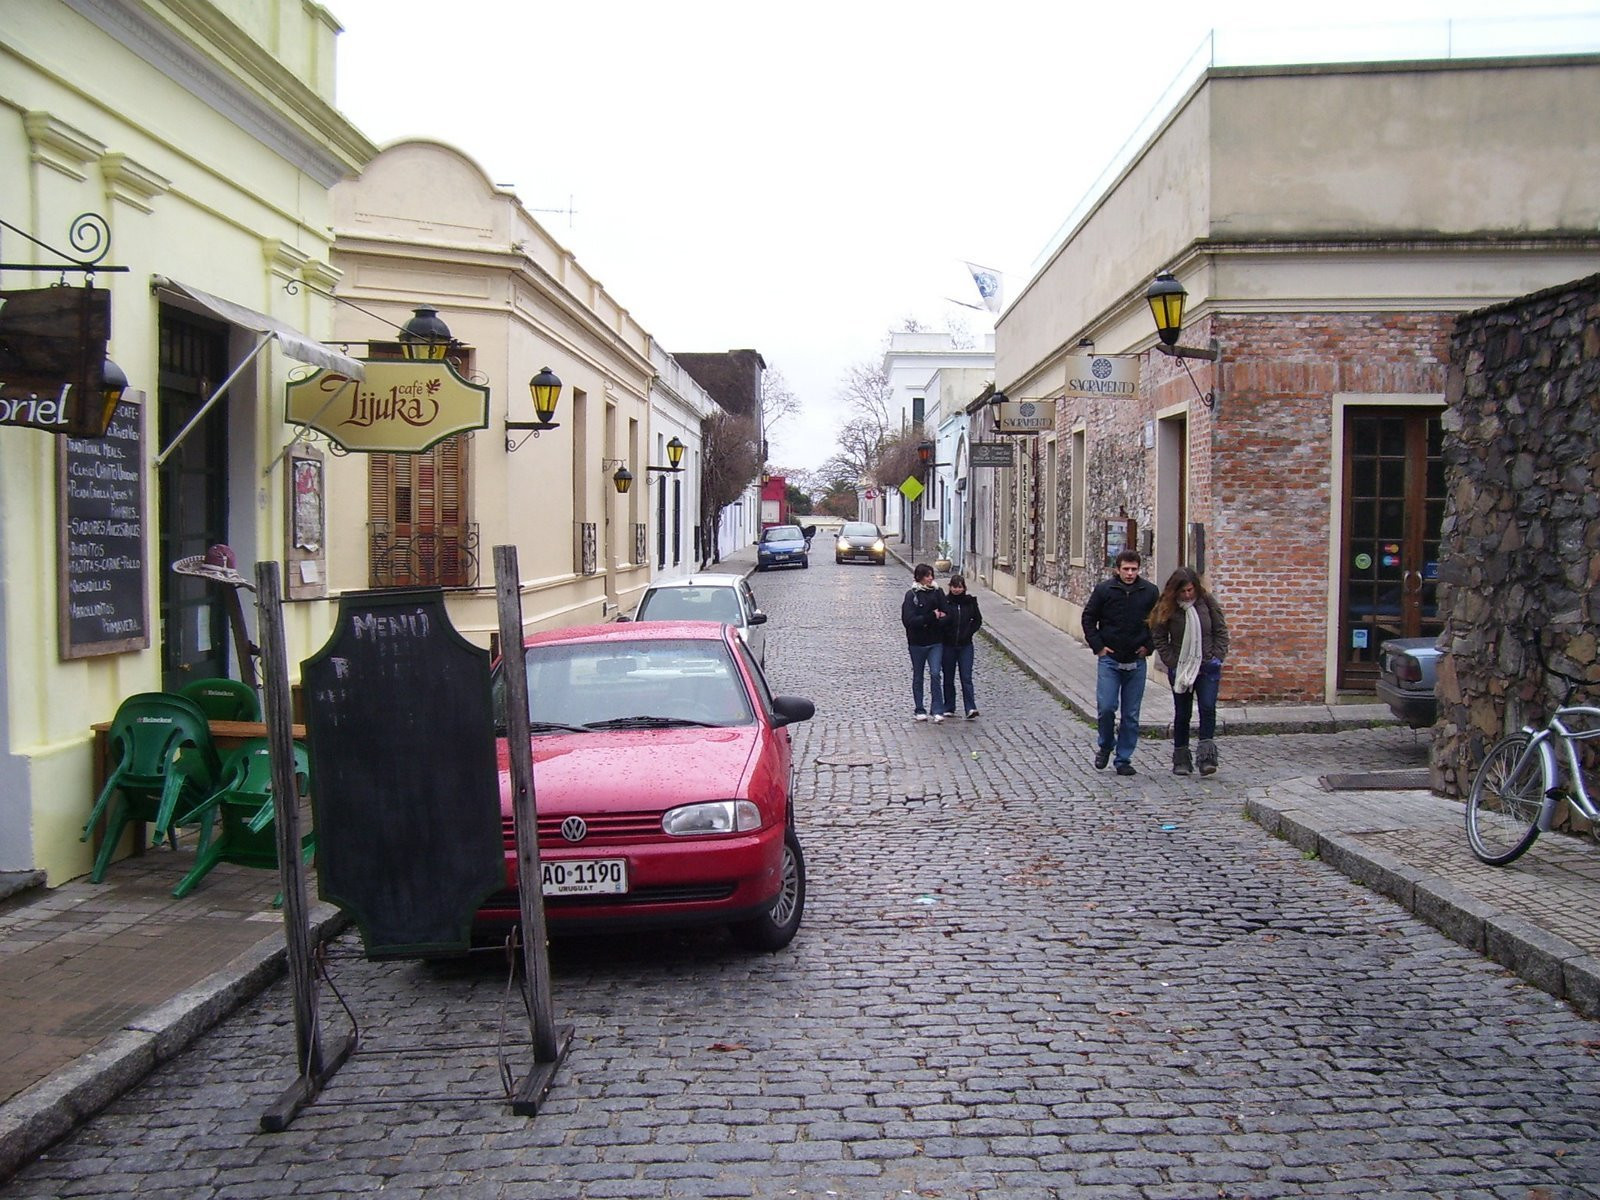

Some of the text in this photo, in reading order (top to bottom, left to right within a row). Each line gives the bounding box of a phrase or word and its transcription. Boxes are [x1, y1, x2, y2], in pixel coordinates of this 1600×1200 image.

[399, 380, 423, 397] café
[1069, 379, 1135, 394] SACRAMENTO
[1003, 418, 1053, 427] SACRAMENTO
